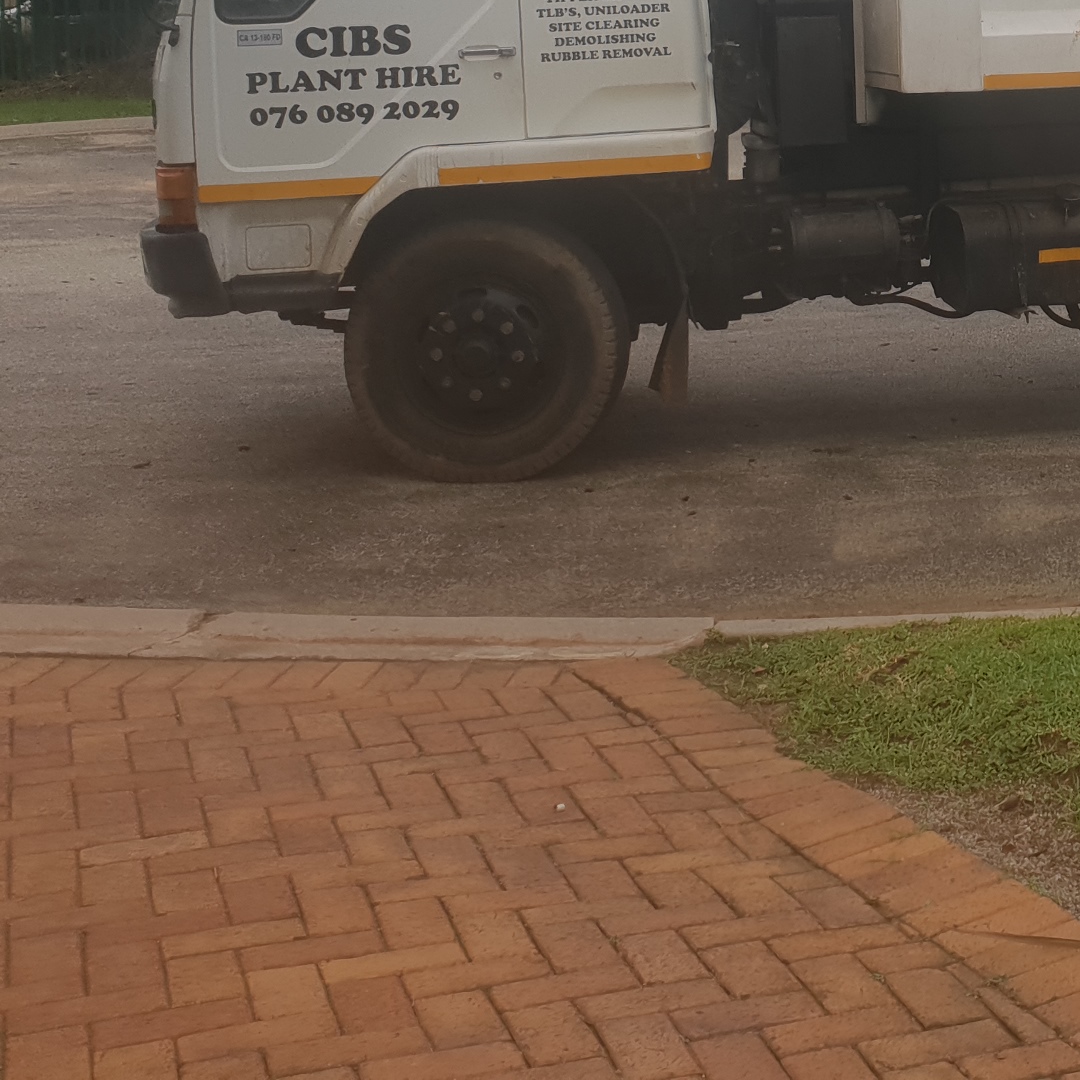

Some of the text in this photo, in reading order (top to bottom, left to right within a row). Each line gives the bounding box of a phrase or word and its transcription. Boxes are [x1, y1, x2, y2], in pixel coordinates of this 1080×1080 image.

[536, 3, 670, 18] TLB'S, UNILOADER
[549, 18, 660, 32] SITE CLEARING
[295, 24, 412, 58] CIBS
[554, 33, 656, 46] DEMOLISHING
[541, 47, 671, 62] RUBBLE REMOVAL
[246, 63, 462, 94] PLANT HIRE
[249, 99, 460, 129] 076 089 2029
